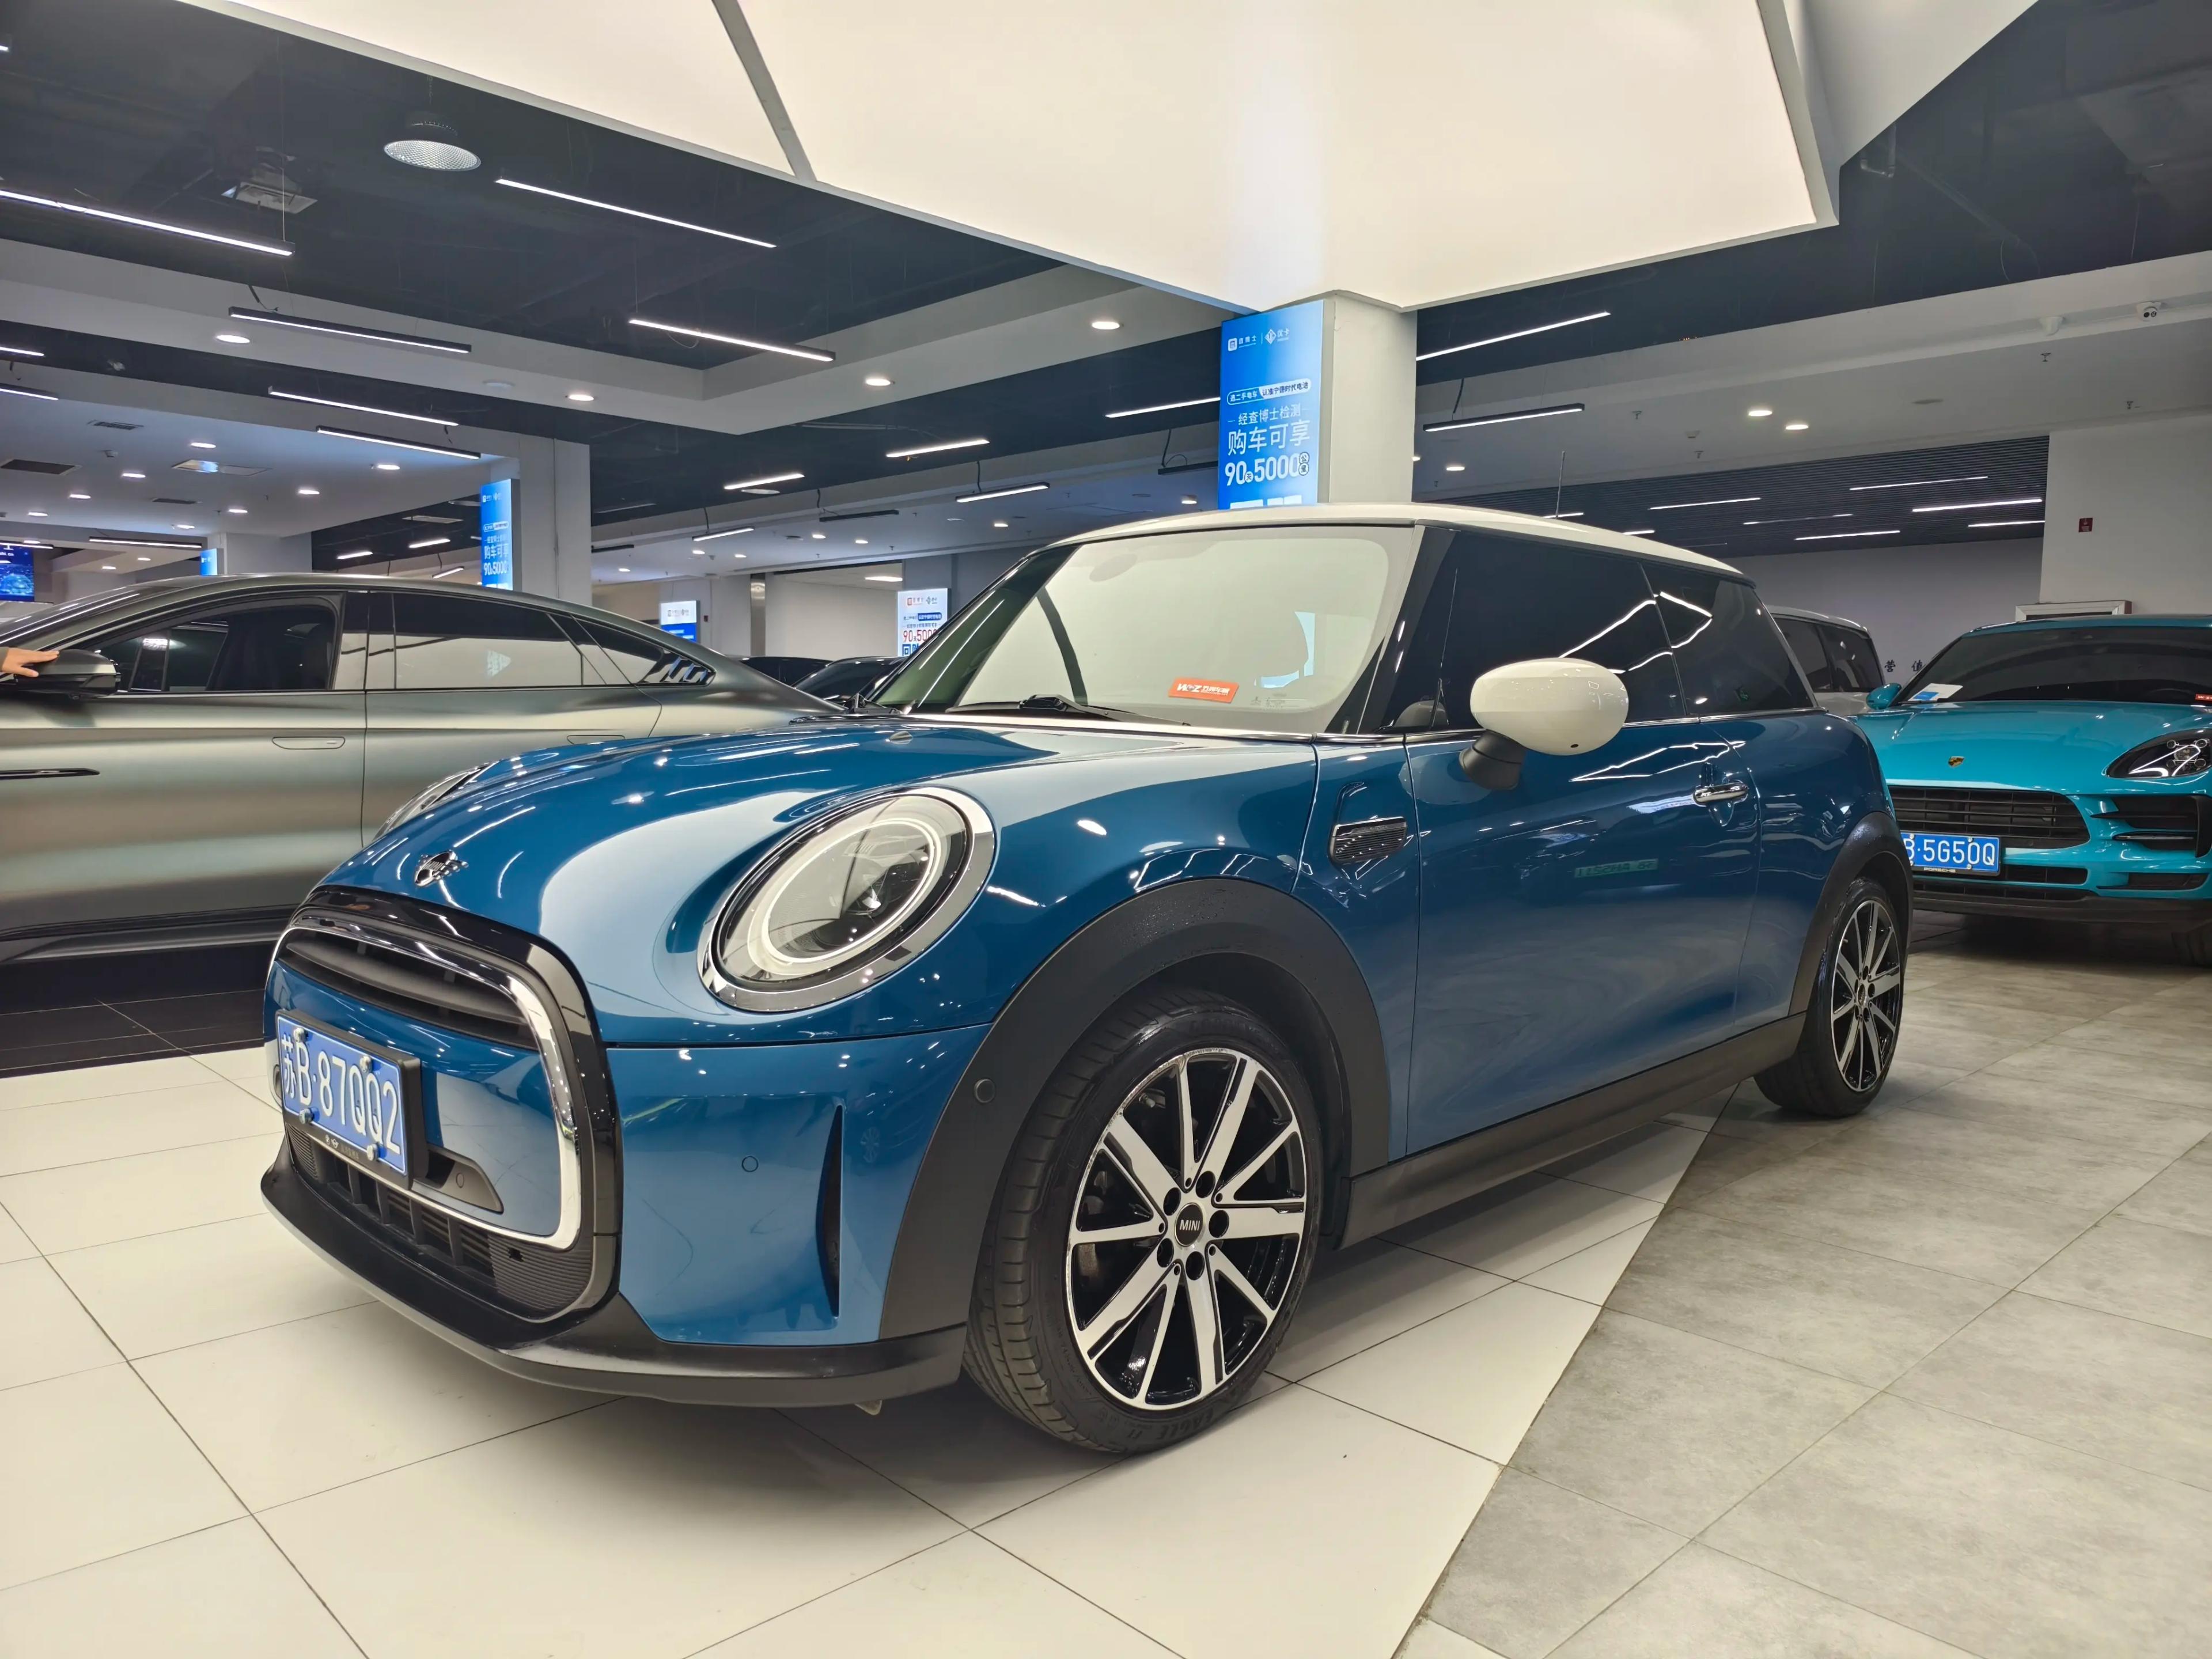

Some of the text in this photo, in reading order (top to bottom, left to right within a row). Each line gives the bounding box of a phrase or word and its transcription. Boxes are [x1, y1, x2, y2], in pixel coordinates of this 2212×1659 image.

[1238, 403, 1301, 426] 经查博士检测
[1228, 419, 1310, 456] 购车可享
[1179, 1219, 1200, 1232] MINI
